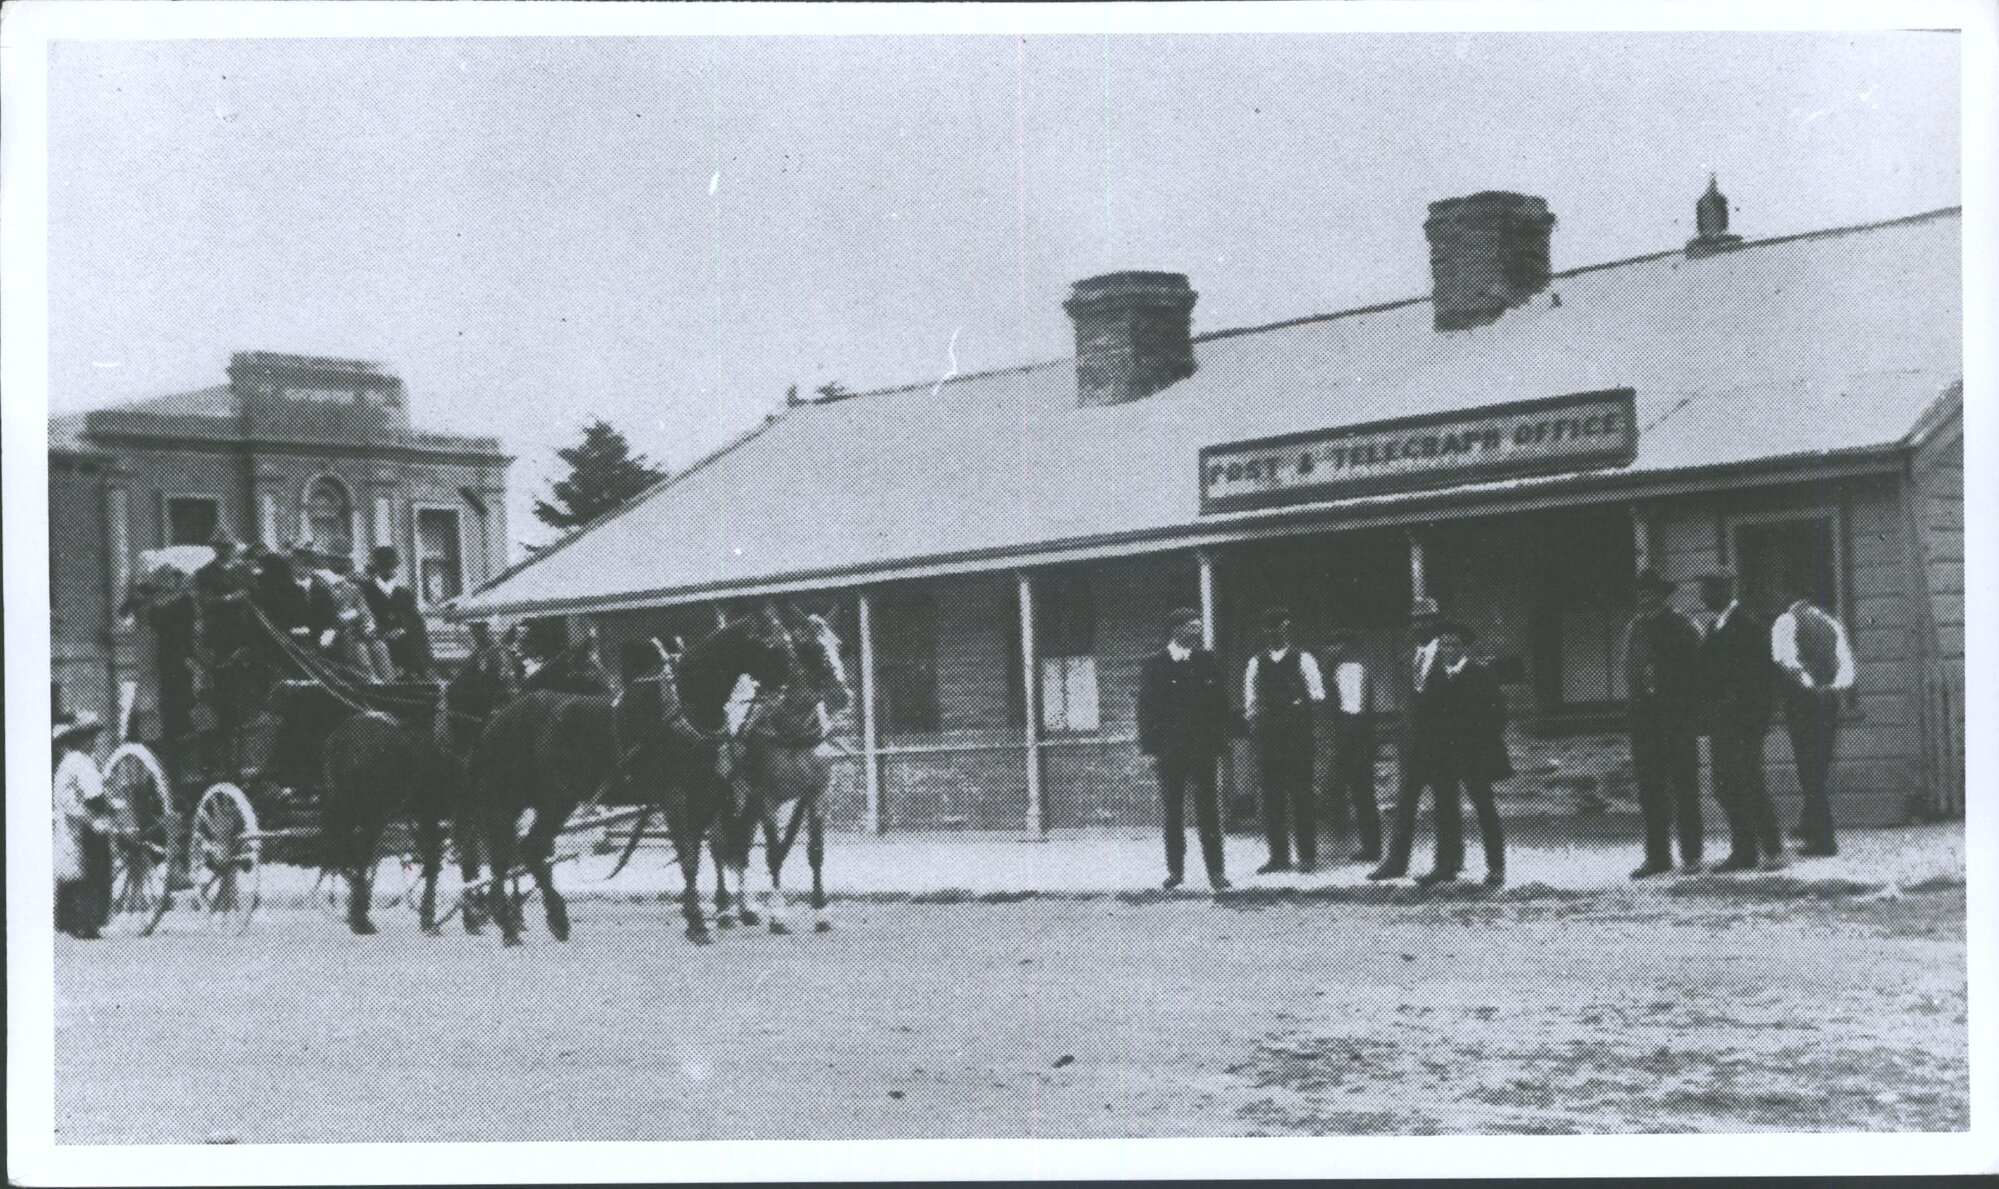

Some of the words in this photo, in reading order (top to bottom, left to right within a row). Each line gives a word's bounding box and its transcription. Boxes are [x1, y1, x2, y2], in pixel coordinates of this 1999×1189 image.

[1209, 455, 1281, 485] POST
[1296, 454, 1315, 475] &
[1332, 429, 1501, 469] TELEGRAPH
[1513, 411, 1620, 445] OFFICE
